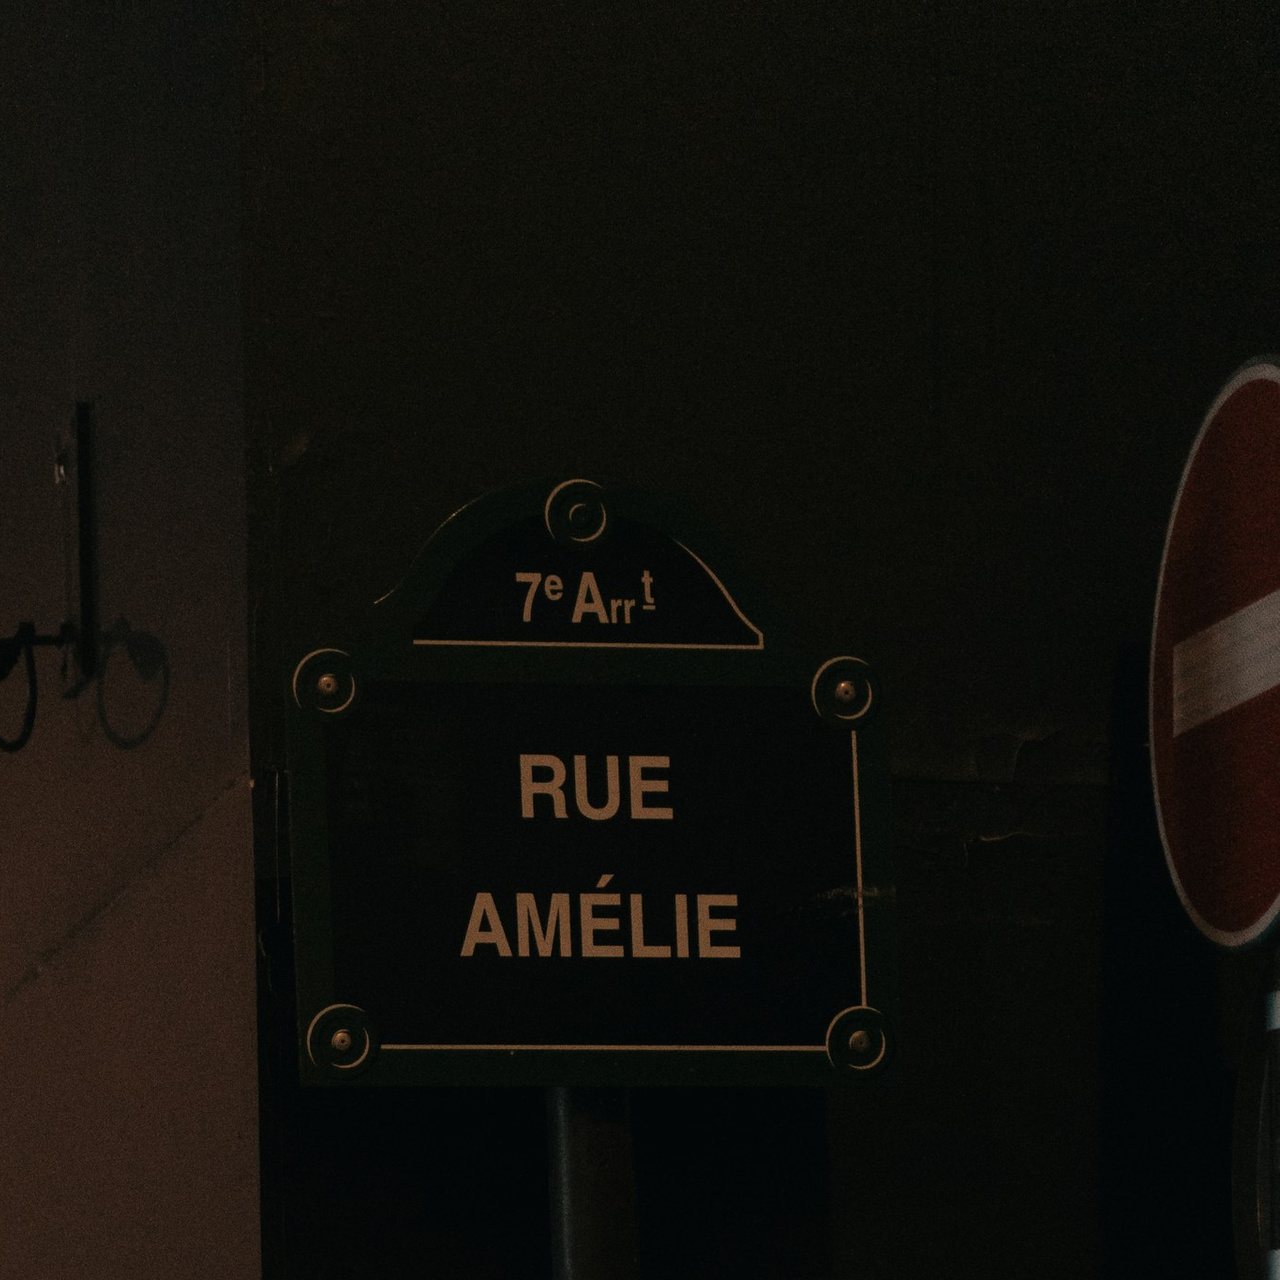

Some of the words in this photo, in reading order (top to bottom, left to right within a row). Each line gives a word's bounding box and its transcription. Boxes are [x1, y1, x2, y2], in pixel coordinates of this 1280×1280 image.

[515, 571, 564, 623] 7e
[518, 753, 675, 821] RUE
[460, 873, 742, 959] AMÉLIE
